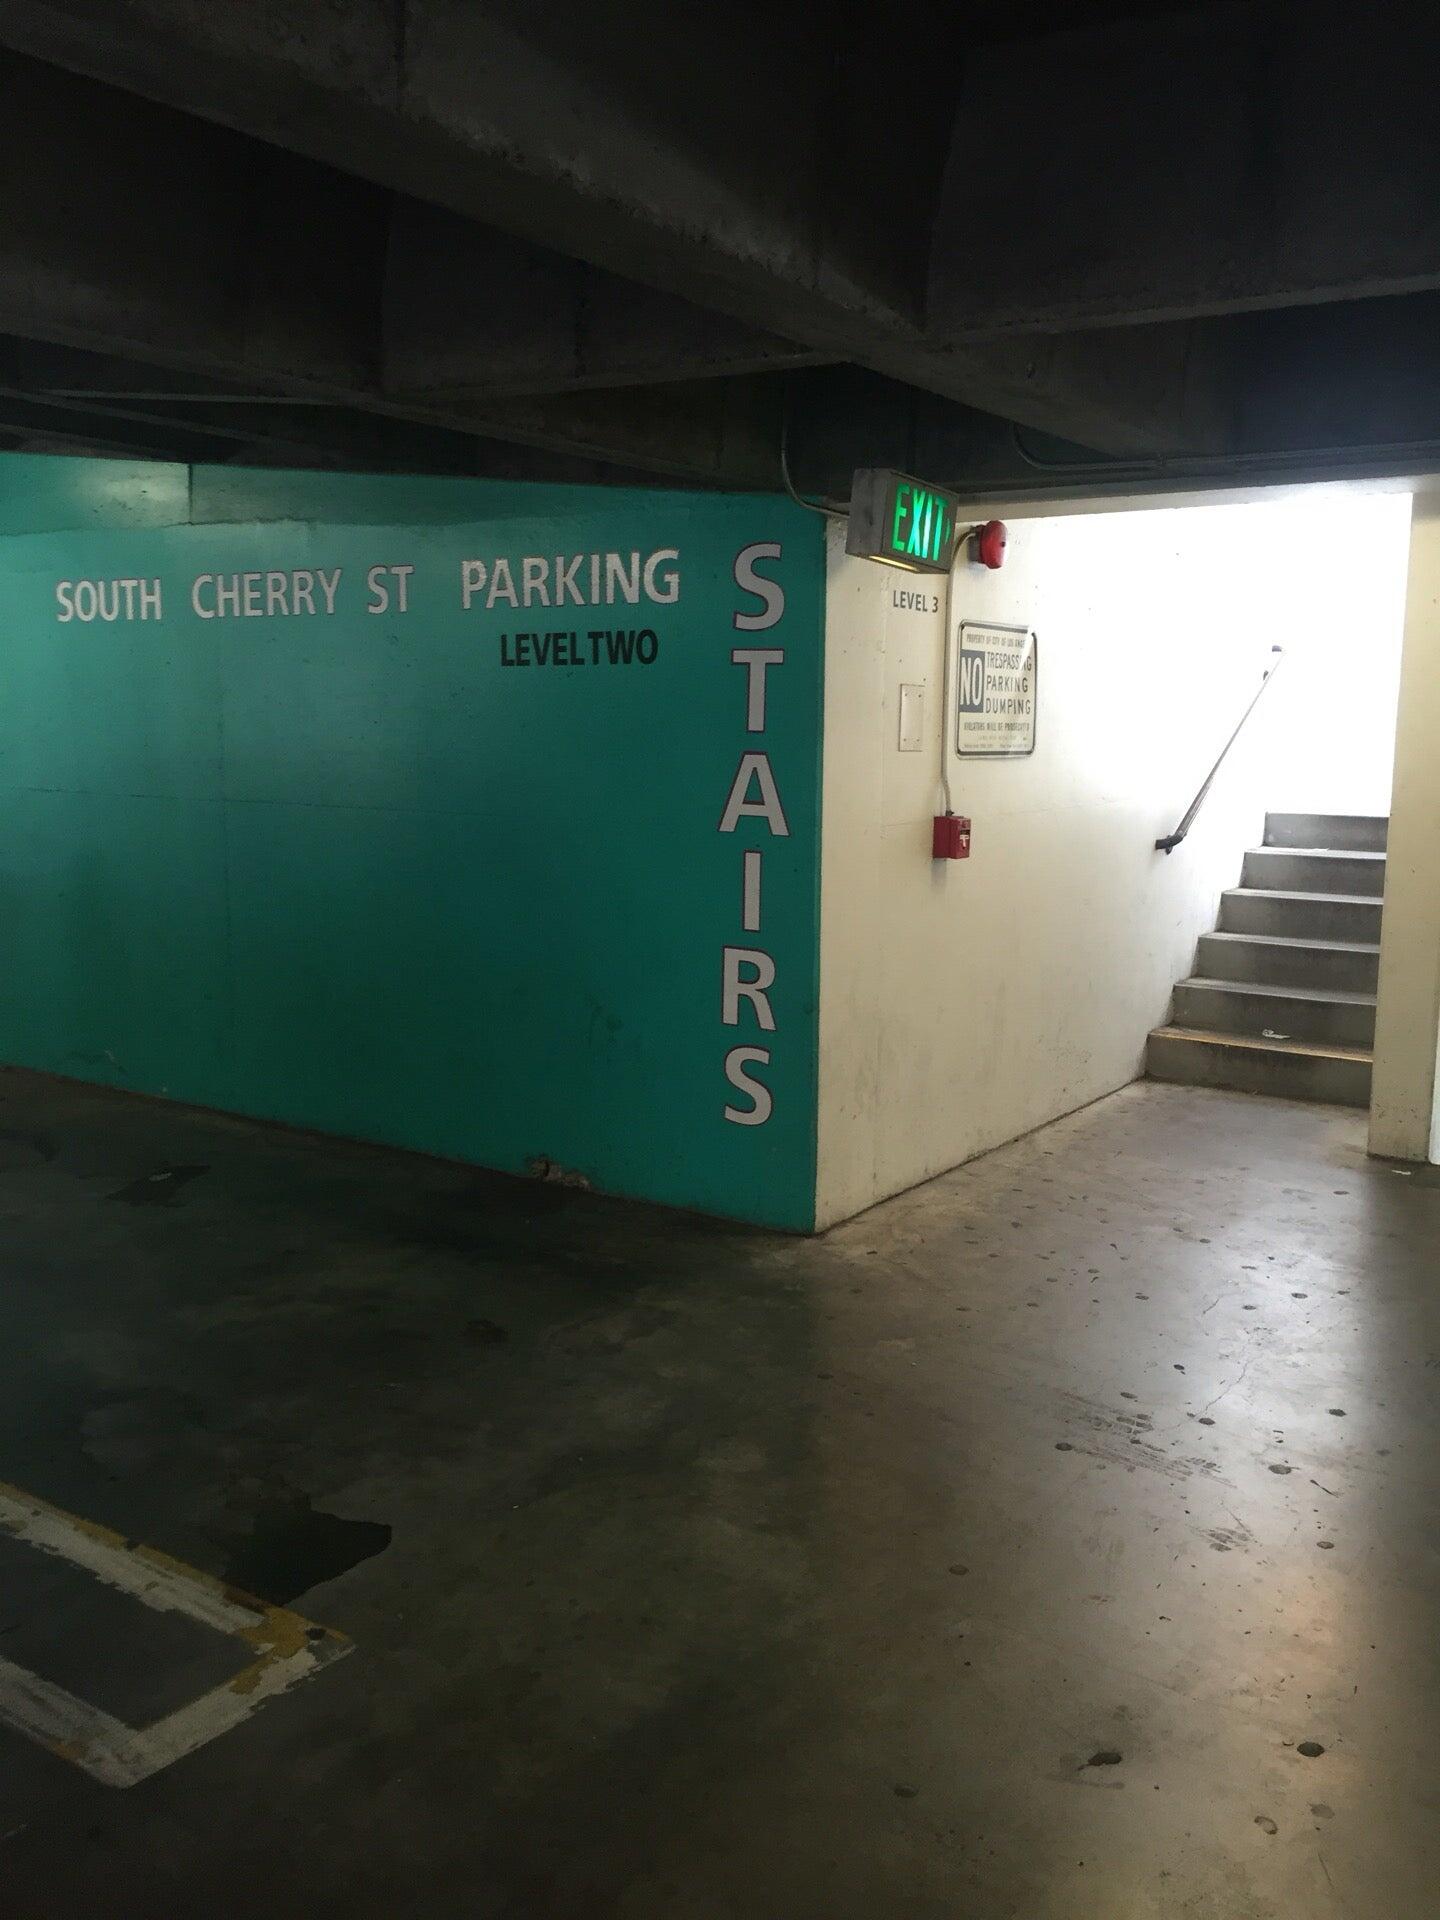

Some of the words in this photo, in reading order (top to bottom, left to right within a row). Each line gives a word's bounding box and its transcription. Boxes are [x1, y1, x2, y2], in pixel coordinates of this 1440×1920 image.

[892, 482, 948, 561] EXIT
[55, 578, 162, 623] SOUTH
[191, 567, 342, 619] CHERRY
[367, 565, 414, 614] ST
[461, 548, 681, 609] PARKING
[893, 590, 928, 613] LEVEL
[931, 596, 939, 613] 3
[960, 656, 983, 706] NO
[986, 651, 1032, 672] TRESPASSNG
[986, 674, 1028, 693] PARKING
[985, 697, 1031, 715] DUMPING
[717, 542, 790, 1127] STAIRS
